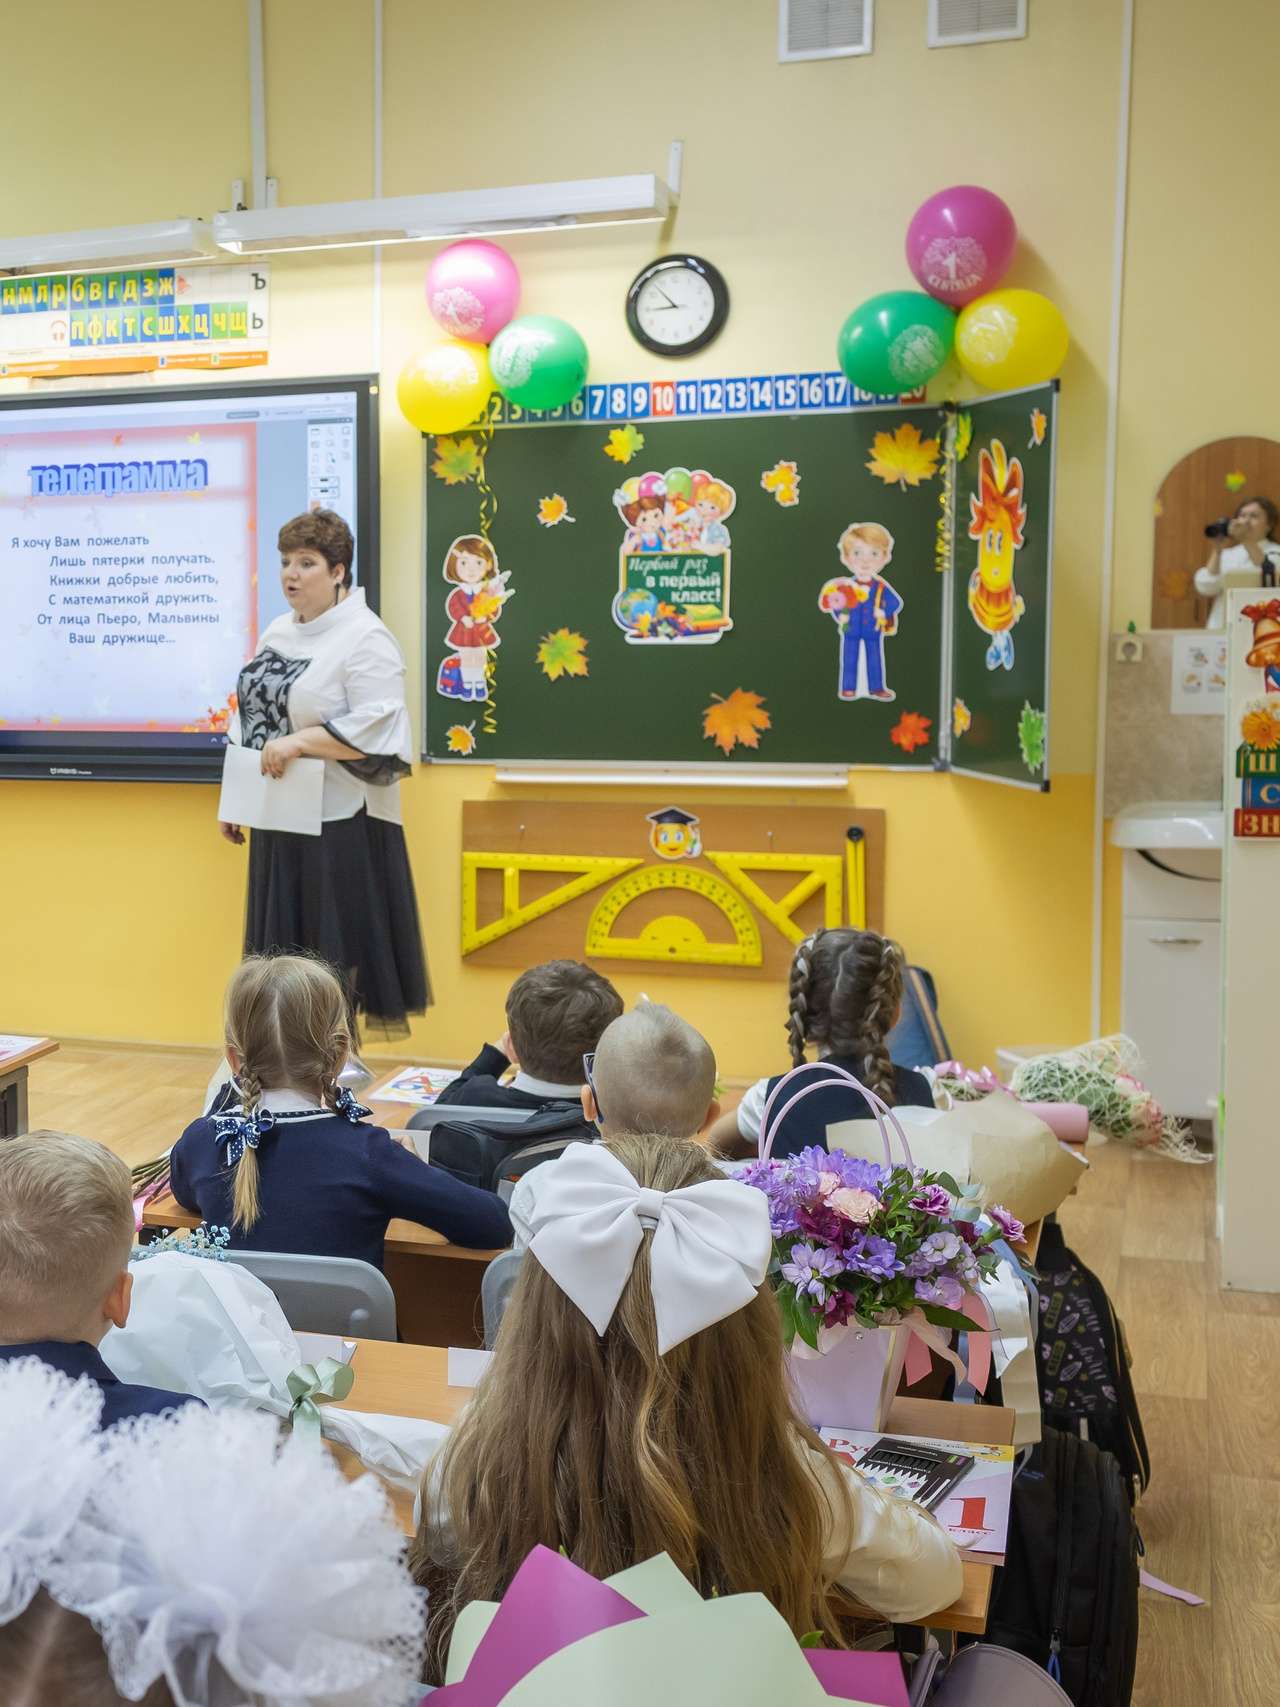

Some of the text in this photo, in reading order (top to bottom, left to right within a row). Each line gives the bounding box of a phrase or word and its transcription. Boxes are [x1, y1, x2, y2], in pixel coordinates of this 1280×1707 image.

[490, 396, 502, 421] 2
[571, 392, 584, 416] 6
[591, 388, 605, 415] 7
[611, 388, 626, 414] 8
[633, 387, 647, 413] 9
[653, 385, 674, 413] 10
[677, 385, 697, 412] 11
[702, 383, 722, 410] 12
[726, 382, 747, 409] 13
[751, 380, 772, 408] 14
[775, 379, 796, 406] 15
[800, 378, 822, 404] 16
[825, 377, 847, 404] 17
[28, 458, 208, 498] телеграмма
[11, 536, 150, 550] Я хочу Вам пожелать
[49, 554, 216, 568] Лишь пятерки получать.
[629, 556, 708, 576] Первый раз
[50, 572, 219, 587] Книжки добрые любить,
[646, 572, 721, 589] в первый
[48, 592, 218, 607] С математикой дружить.
[671, 587, 721, 603] класс!
[37, 612, 220, 626] От лица Пьеро, Мальвины
[69, 633, 176, 645] Ваш дружище...
[948, 1497, 995, 1531] 1
[948, 1527, 992, 1536] класс
